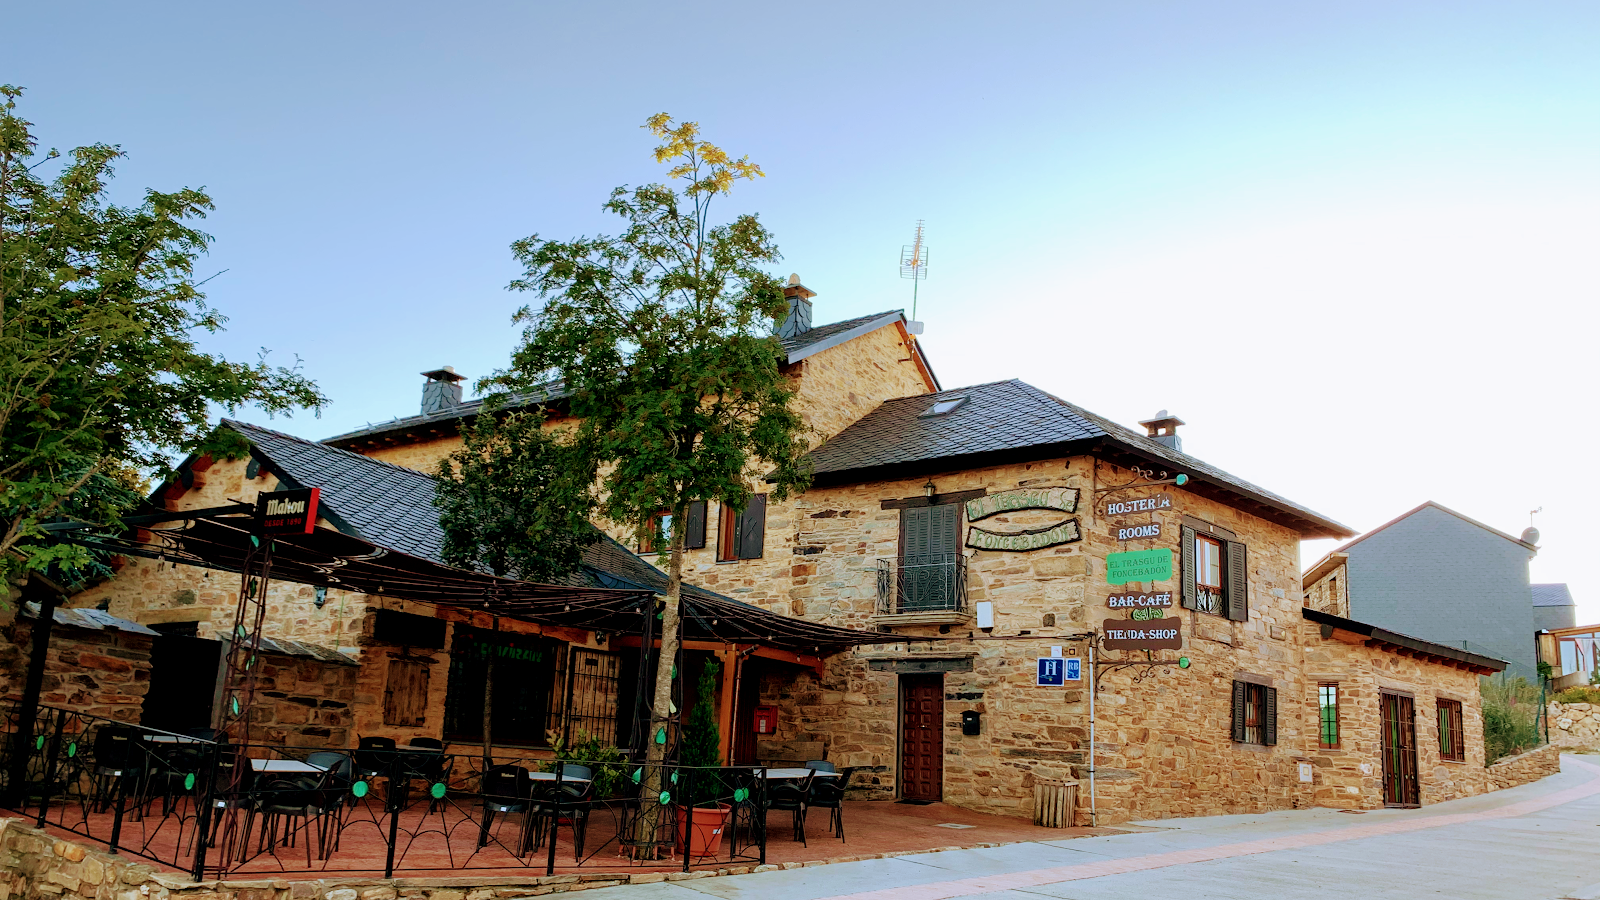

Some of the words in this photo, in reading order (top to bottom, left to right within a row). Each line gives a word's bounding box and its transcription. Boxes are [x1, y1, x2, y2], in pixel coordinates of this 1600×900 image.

[266, 497, 305, 516] Mahou
[1108, 494, 1170, 514] HOSTERÍA
[264, 519, 284, 527] DESDE
[1119, 524, 1160, 539] ROOMS
[1122, 557, 1155, 567] TRASGU
[1157, 556, 1168, 564] DE
[1109, 591, 1171, 607] BAR-CAFÉ
[1107, 629, 1177, 640] TIENDA-SHOP
[1068, 662, 1079, 671] RB
